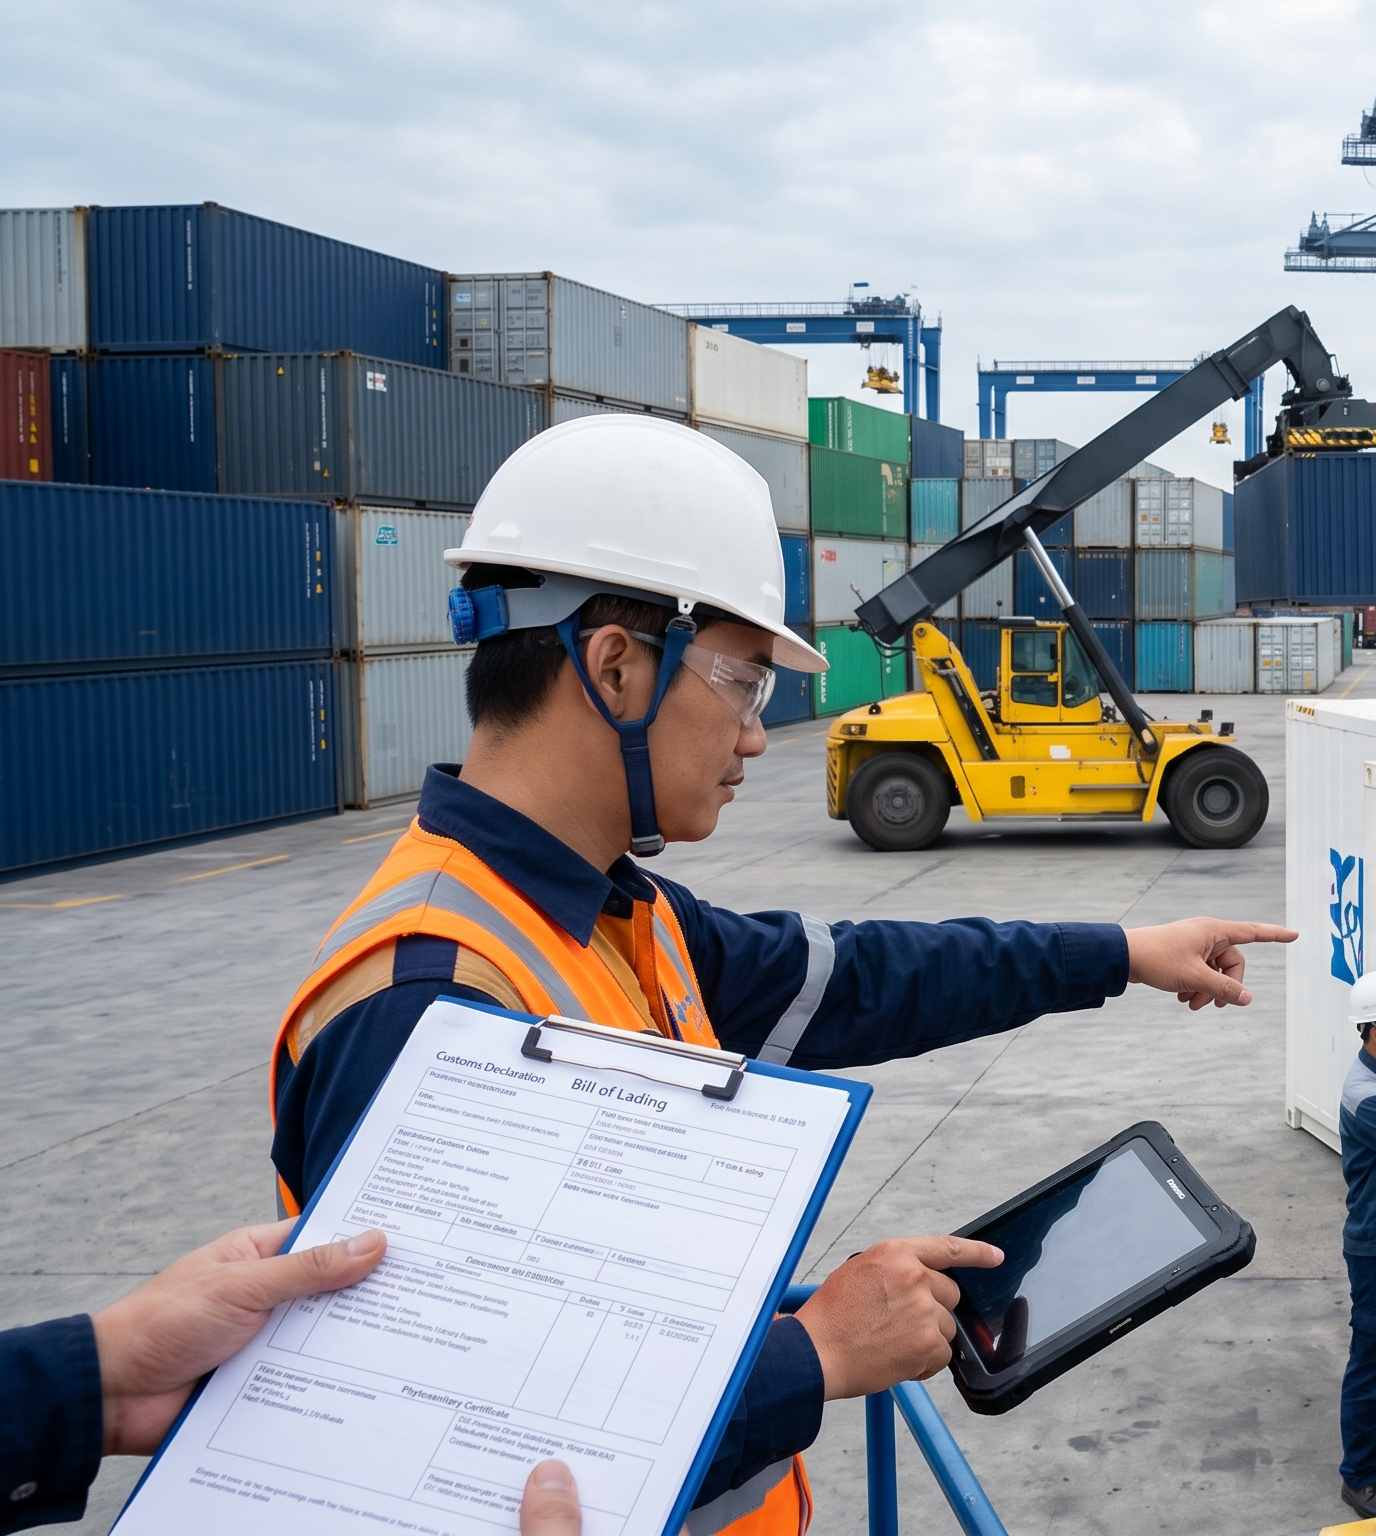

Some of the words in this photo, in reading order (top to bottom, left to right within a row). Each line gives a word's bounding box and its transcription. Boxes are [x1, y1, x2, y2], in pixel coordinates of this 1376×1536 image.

[436, 1051, 483, 1070] Customs
[484, 1062, 546, 1085] Declaration
[571, 1078, 597, 1094] Bill
[598, 1086, 615, 1098] of
[616, 1088, 668, 1113] Lading
